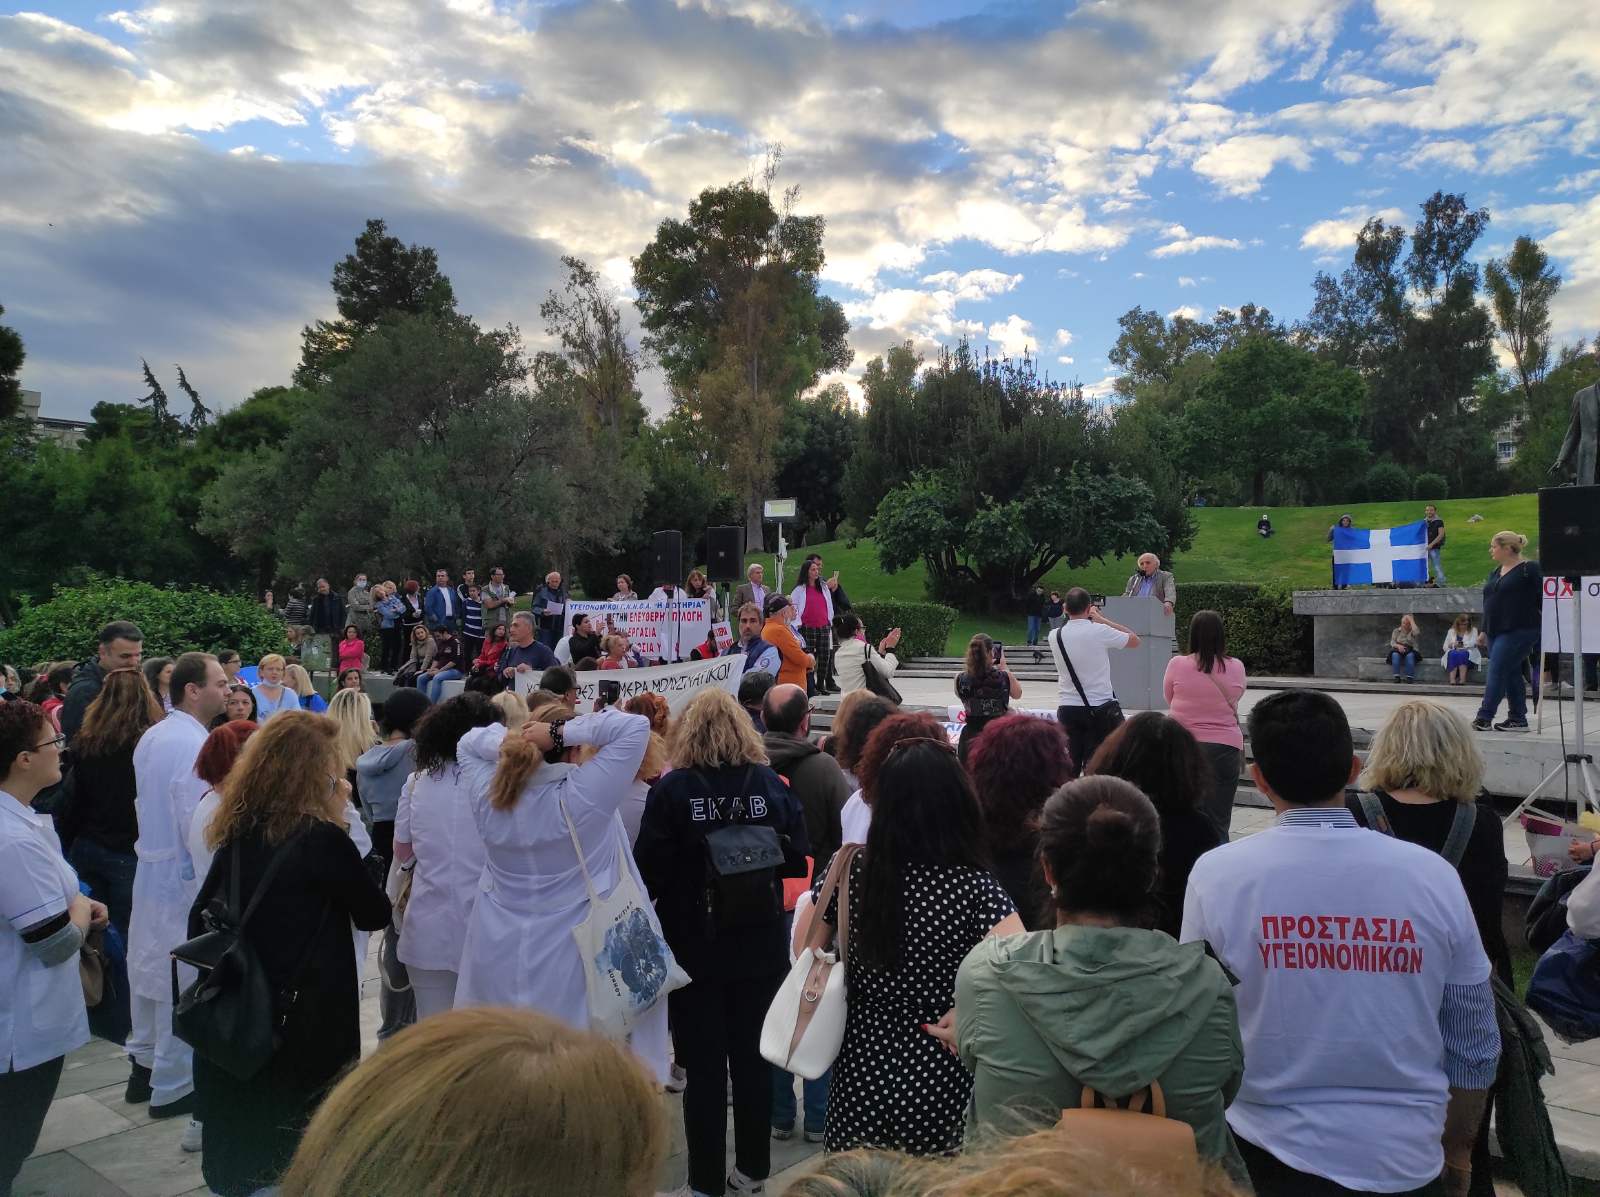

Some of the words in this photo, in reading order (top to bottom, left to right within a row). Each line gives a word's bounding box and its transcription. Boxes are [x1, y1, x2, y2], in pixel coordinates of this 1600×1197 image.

[629, 611, 665, 622] ΕΛΕΥΘΕΡΗ
[1261, 915, 1416, 943] ΠΡΟΣΤΑΣΙΑ
[1258, 942, 1423, 973] ΥΓΕΙΟΝΟΜΙΚΩΝ
